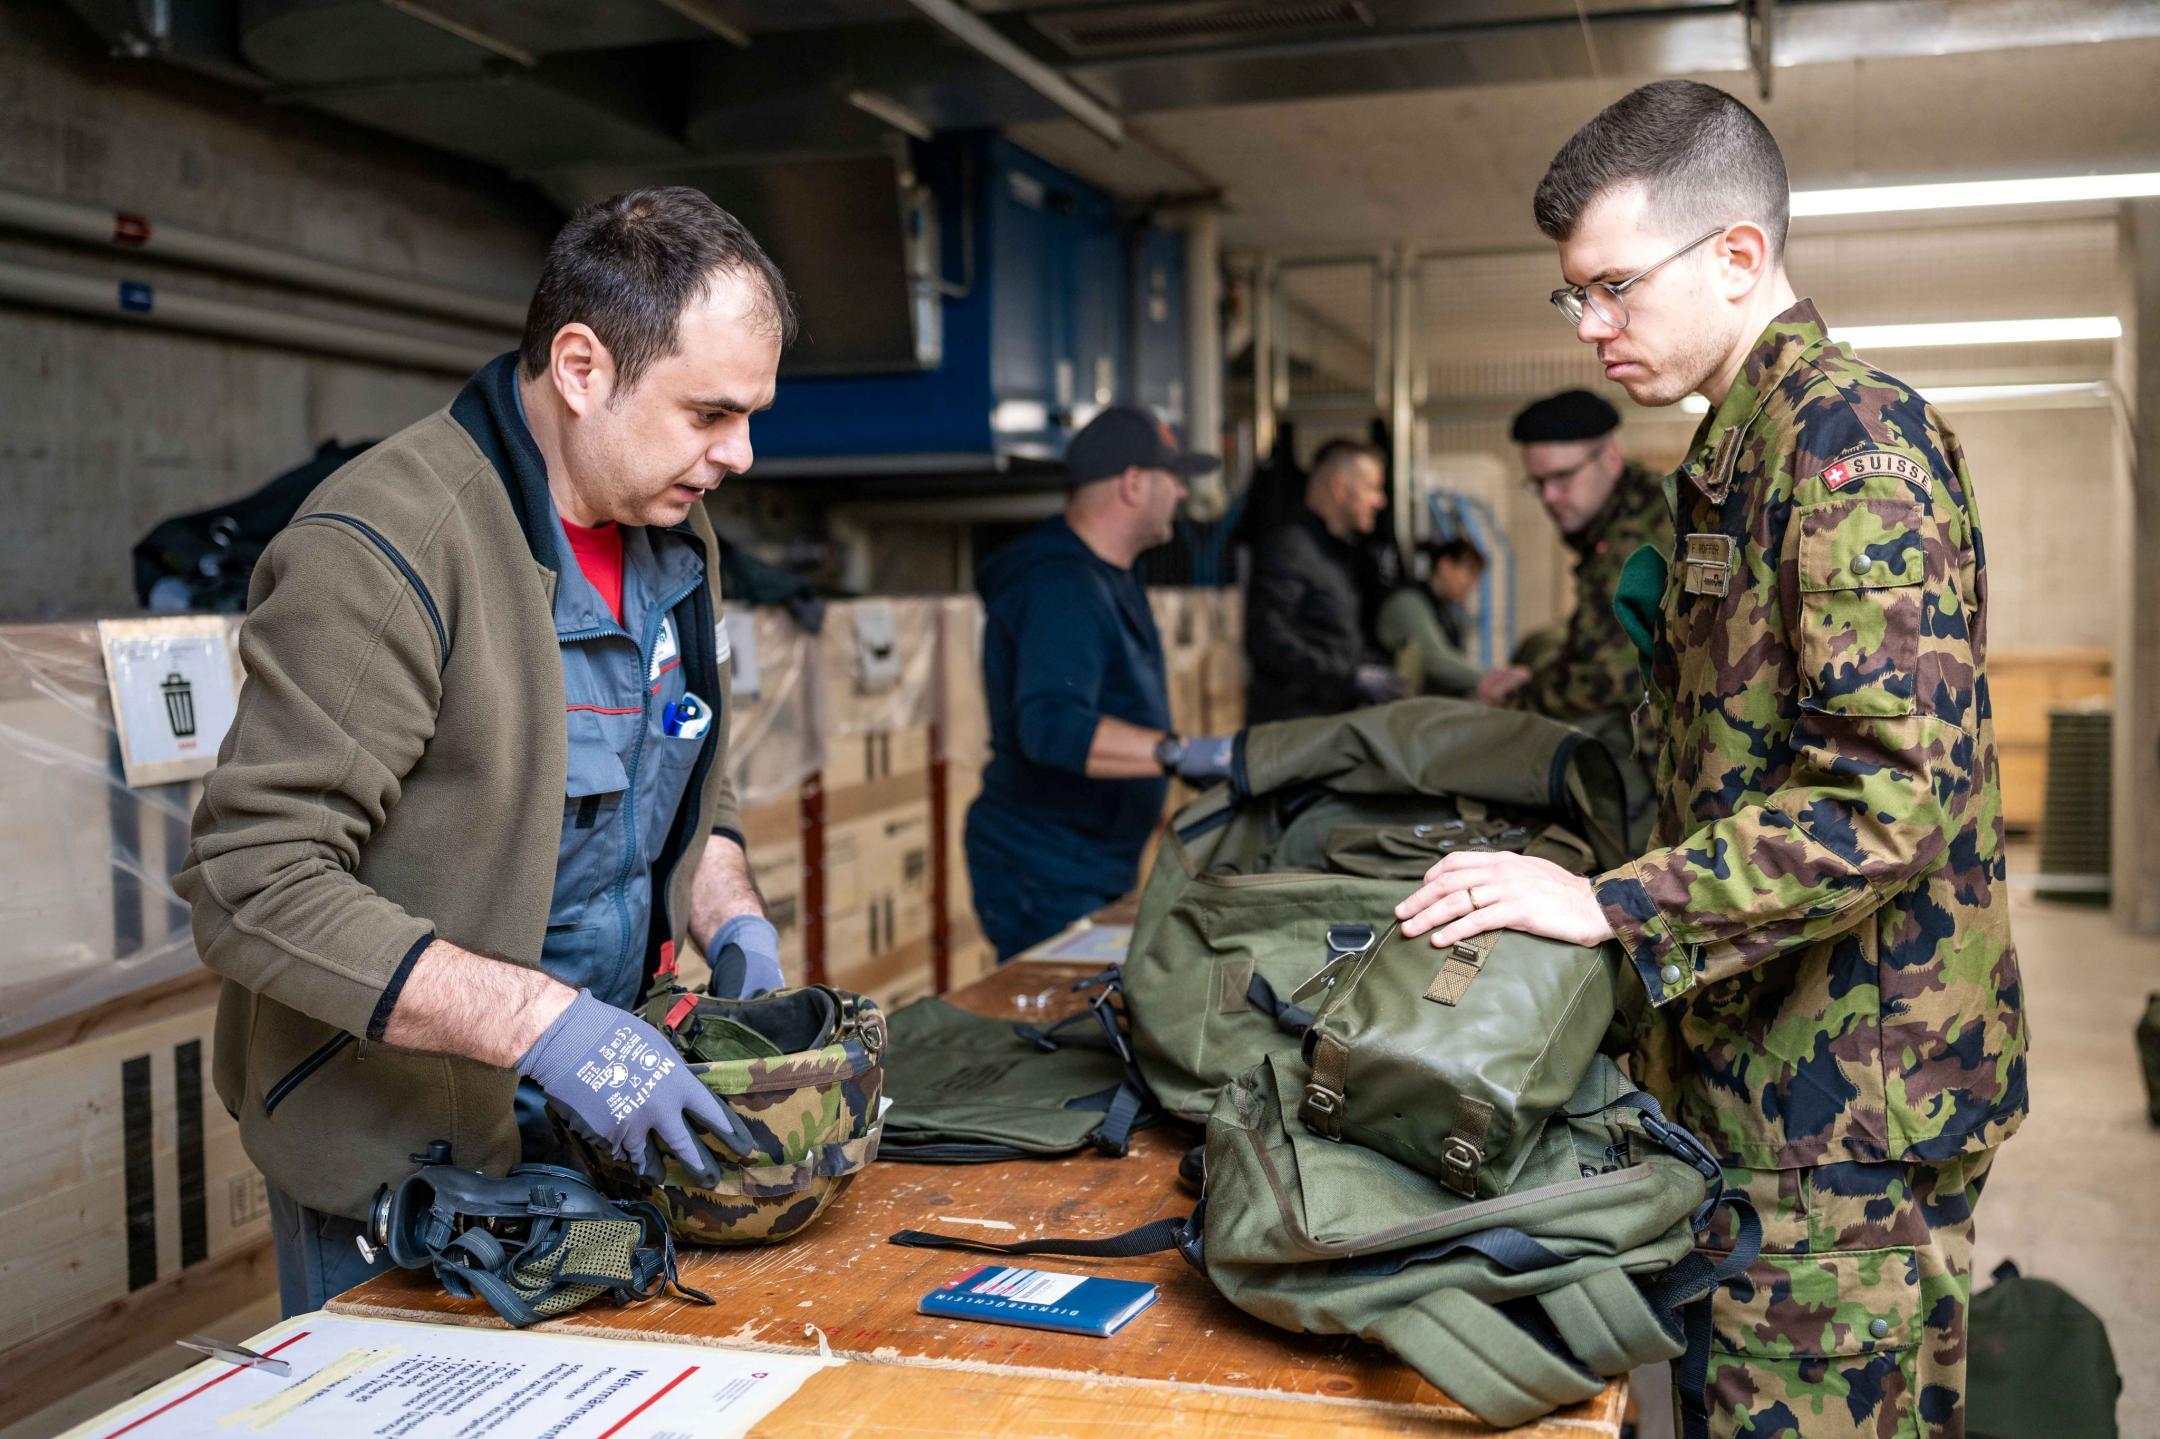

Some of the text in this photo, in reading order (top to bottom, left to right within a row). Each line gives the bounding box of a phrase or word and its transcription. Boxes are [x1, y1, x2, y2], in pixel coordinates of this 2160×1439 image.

[1853, 455, 1930, 487] SUISSE
[615, 1058, 675, 1120] MaxiFlex
[934, 1293, 1081, 1317] DIENSTBÜCHLEIN
[417, 1364, 462, 1387] TAZ Hose
[425, 1362, 448, 1371] TAZ
[369, 1381, 396, 1394] Hose
[566, 1367, 616, 1399] Pflichtartikel
